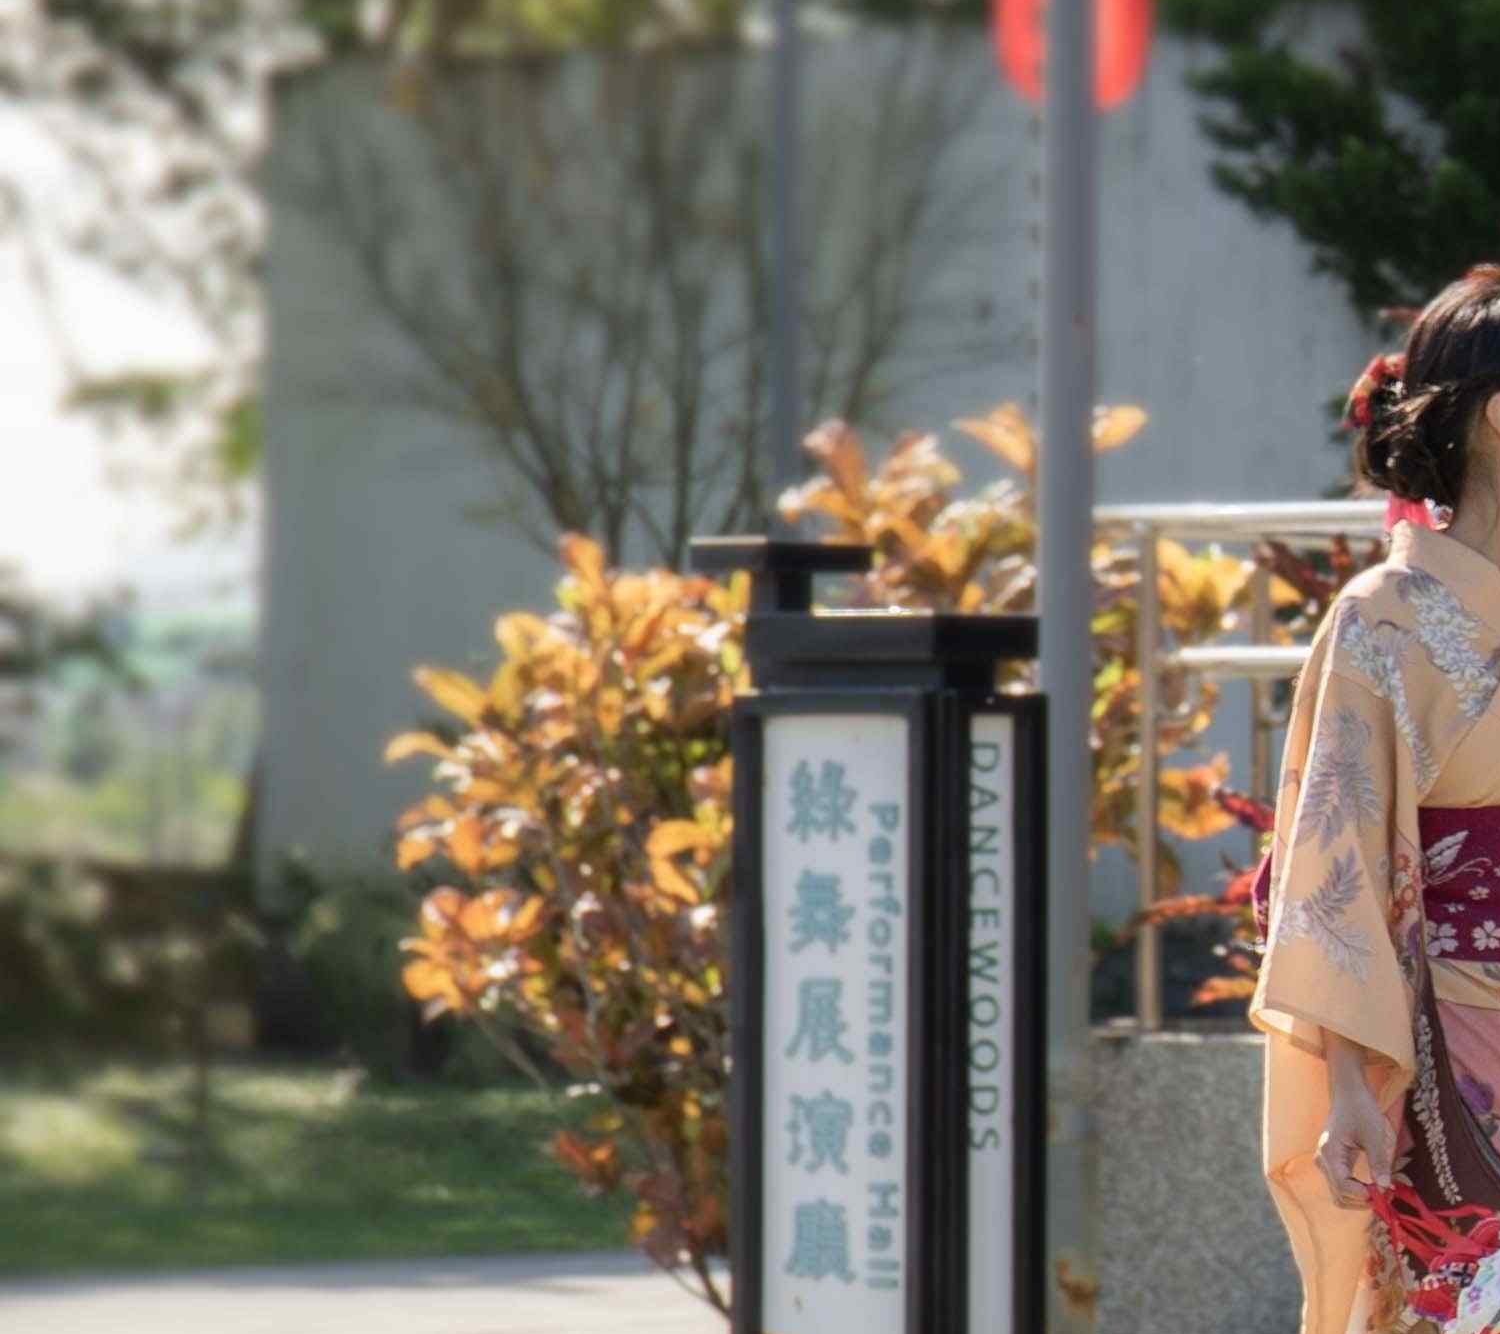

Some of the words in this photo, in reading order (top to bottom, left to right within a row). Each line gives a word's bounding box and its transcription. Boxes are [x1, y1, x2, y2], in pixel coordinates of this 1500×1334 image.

[786, 759, 857, 1284] 綠舞展演廳
[868, 803, 902, 1158] Performance
[969, 741, 1000, 1150] DANCEWOODS
[867, 1178, 900, 1290] Hall
